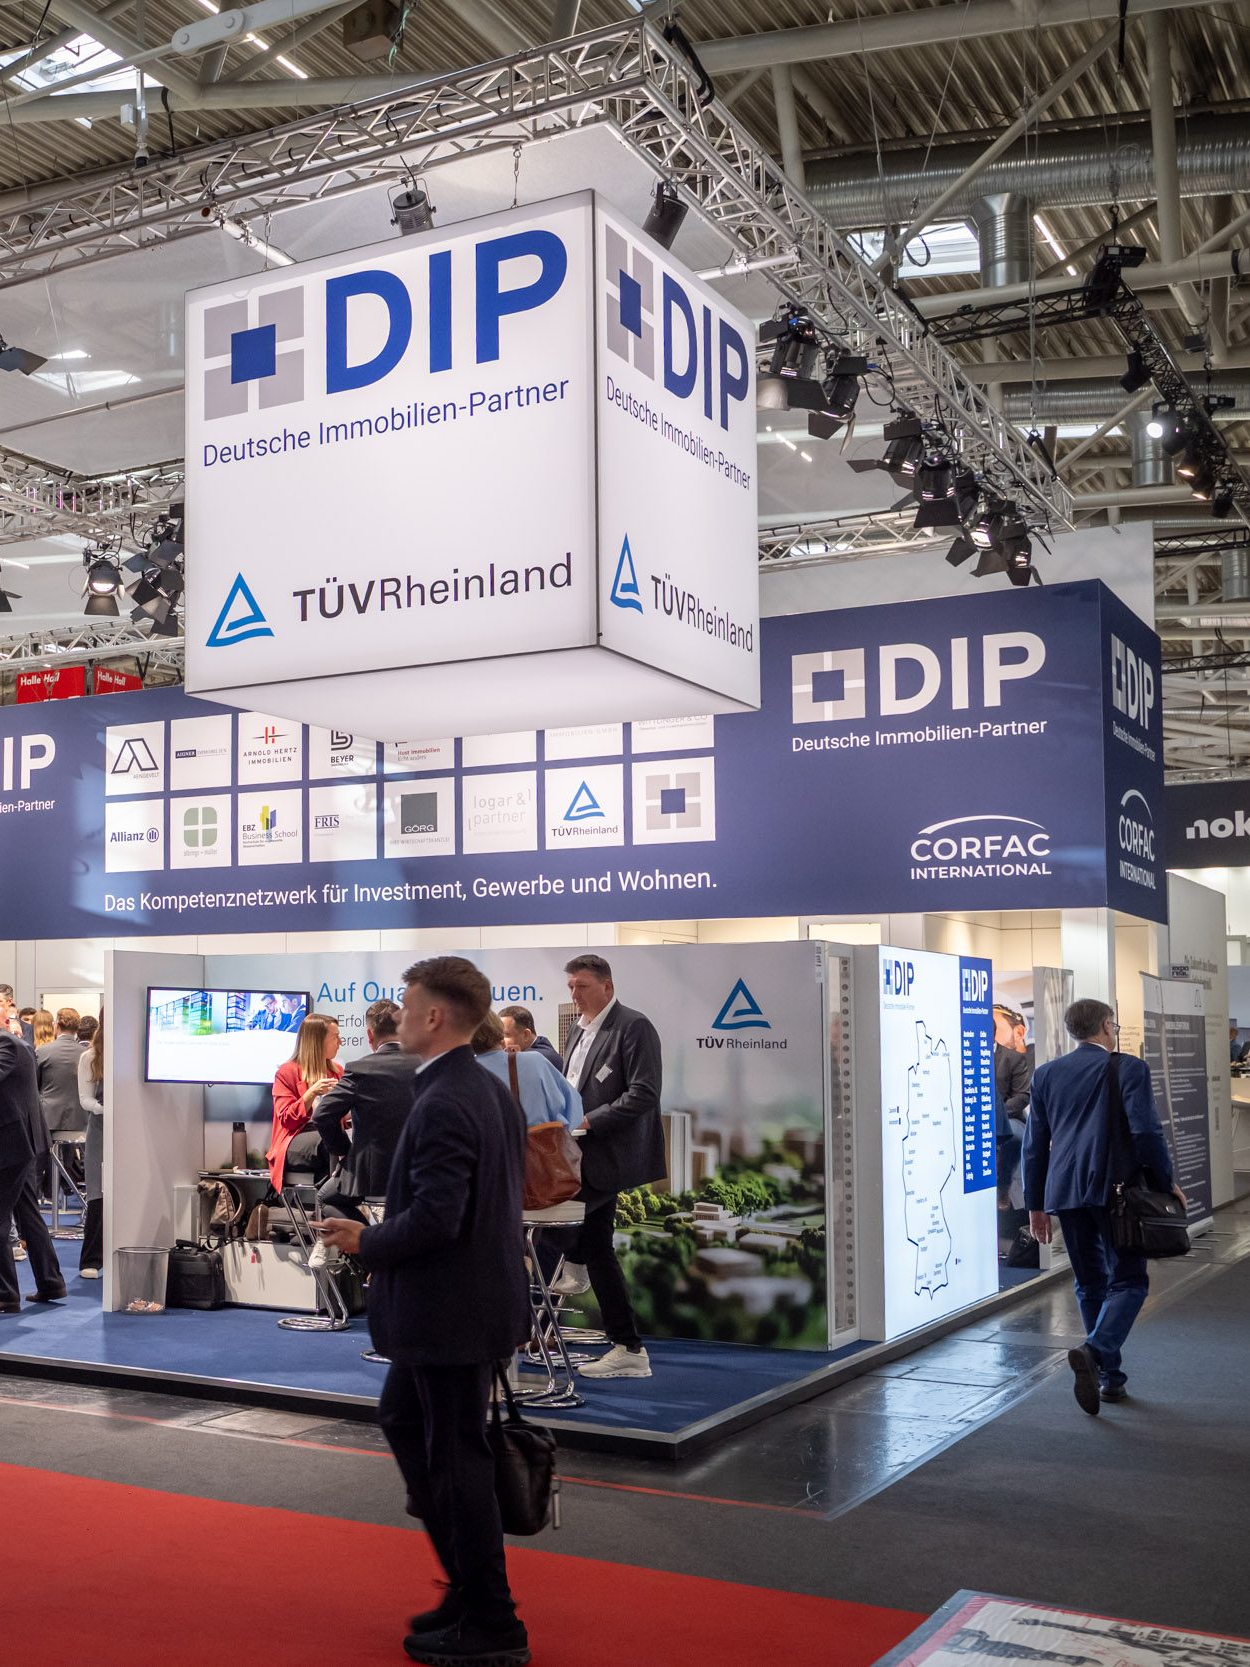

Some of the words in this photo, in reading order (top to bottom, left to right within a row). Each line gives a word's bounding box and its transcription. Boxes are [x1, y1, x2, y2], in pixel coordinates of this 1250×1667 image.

[325, 229, 568, 396] DIP
[662, 271, 749, 432] DIP
[203, 428, 311, 468] Deutsche
[318, 379, 569, 445] Immobilien-Partner
[606, 375, 659, 432] Deutsche
[660, 415, 751, 492] Immobilien-Partner
[20, 675, 41, 686] Halle
[43, 672, 60, 683] Hall
[97, 671, 113, 683] Halle
[879, 631, 1046, 716] DIP
[1127, 651, 1154, 731] DIP
[792, 732, 870, 753] Deutsche
[875, 719, 1048, 747] Immobilien-Partner
[248, 757, 292, 765] IMMOBILIEN
[331, 755, 354, 763] BEYER
[404, 824, 435, 833] GÖRG
[474, 811, 527, 827] partner
[110, 831, 145, 843] Allianz
[242, 831, 272, 840] Business
[274, 830, 298, 838] School
[910, 833, 1050, 862] CORFAC
[1119, 814, 1155, 862] CORFAC
[911, 862, 1052, 880] INTERNATIONAL
[1119, 860, 1156, 890] INTERNATIONAL
[104, 894, 135, 911] Das
[140, 884, 317, 913] Kompetenznetzwerk
[322, 883, 348, 901] für
[354, 879, 467, 902] Investment,
[472, 874, 564, 897] Gewerbe
[571, 872, 611, 894] und
[618, 868, 718, 891] Wohnen.
[317, 982, 356, 1002] Auf
[363, 981, 405, 1003] Qua
[492, 985, 543, 1002] uen.
[894, 960, 914, 996] DIP
[971, 969, 989, 1002] DIP
[337, 1014, 366, 1028] Erfol
[340, 1036, 364, 1046] erer
